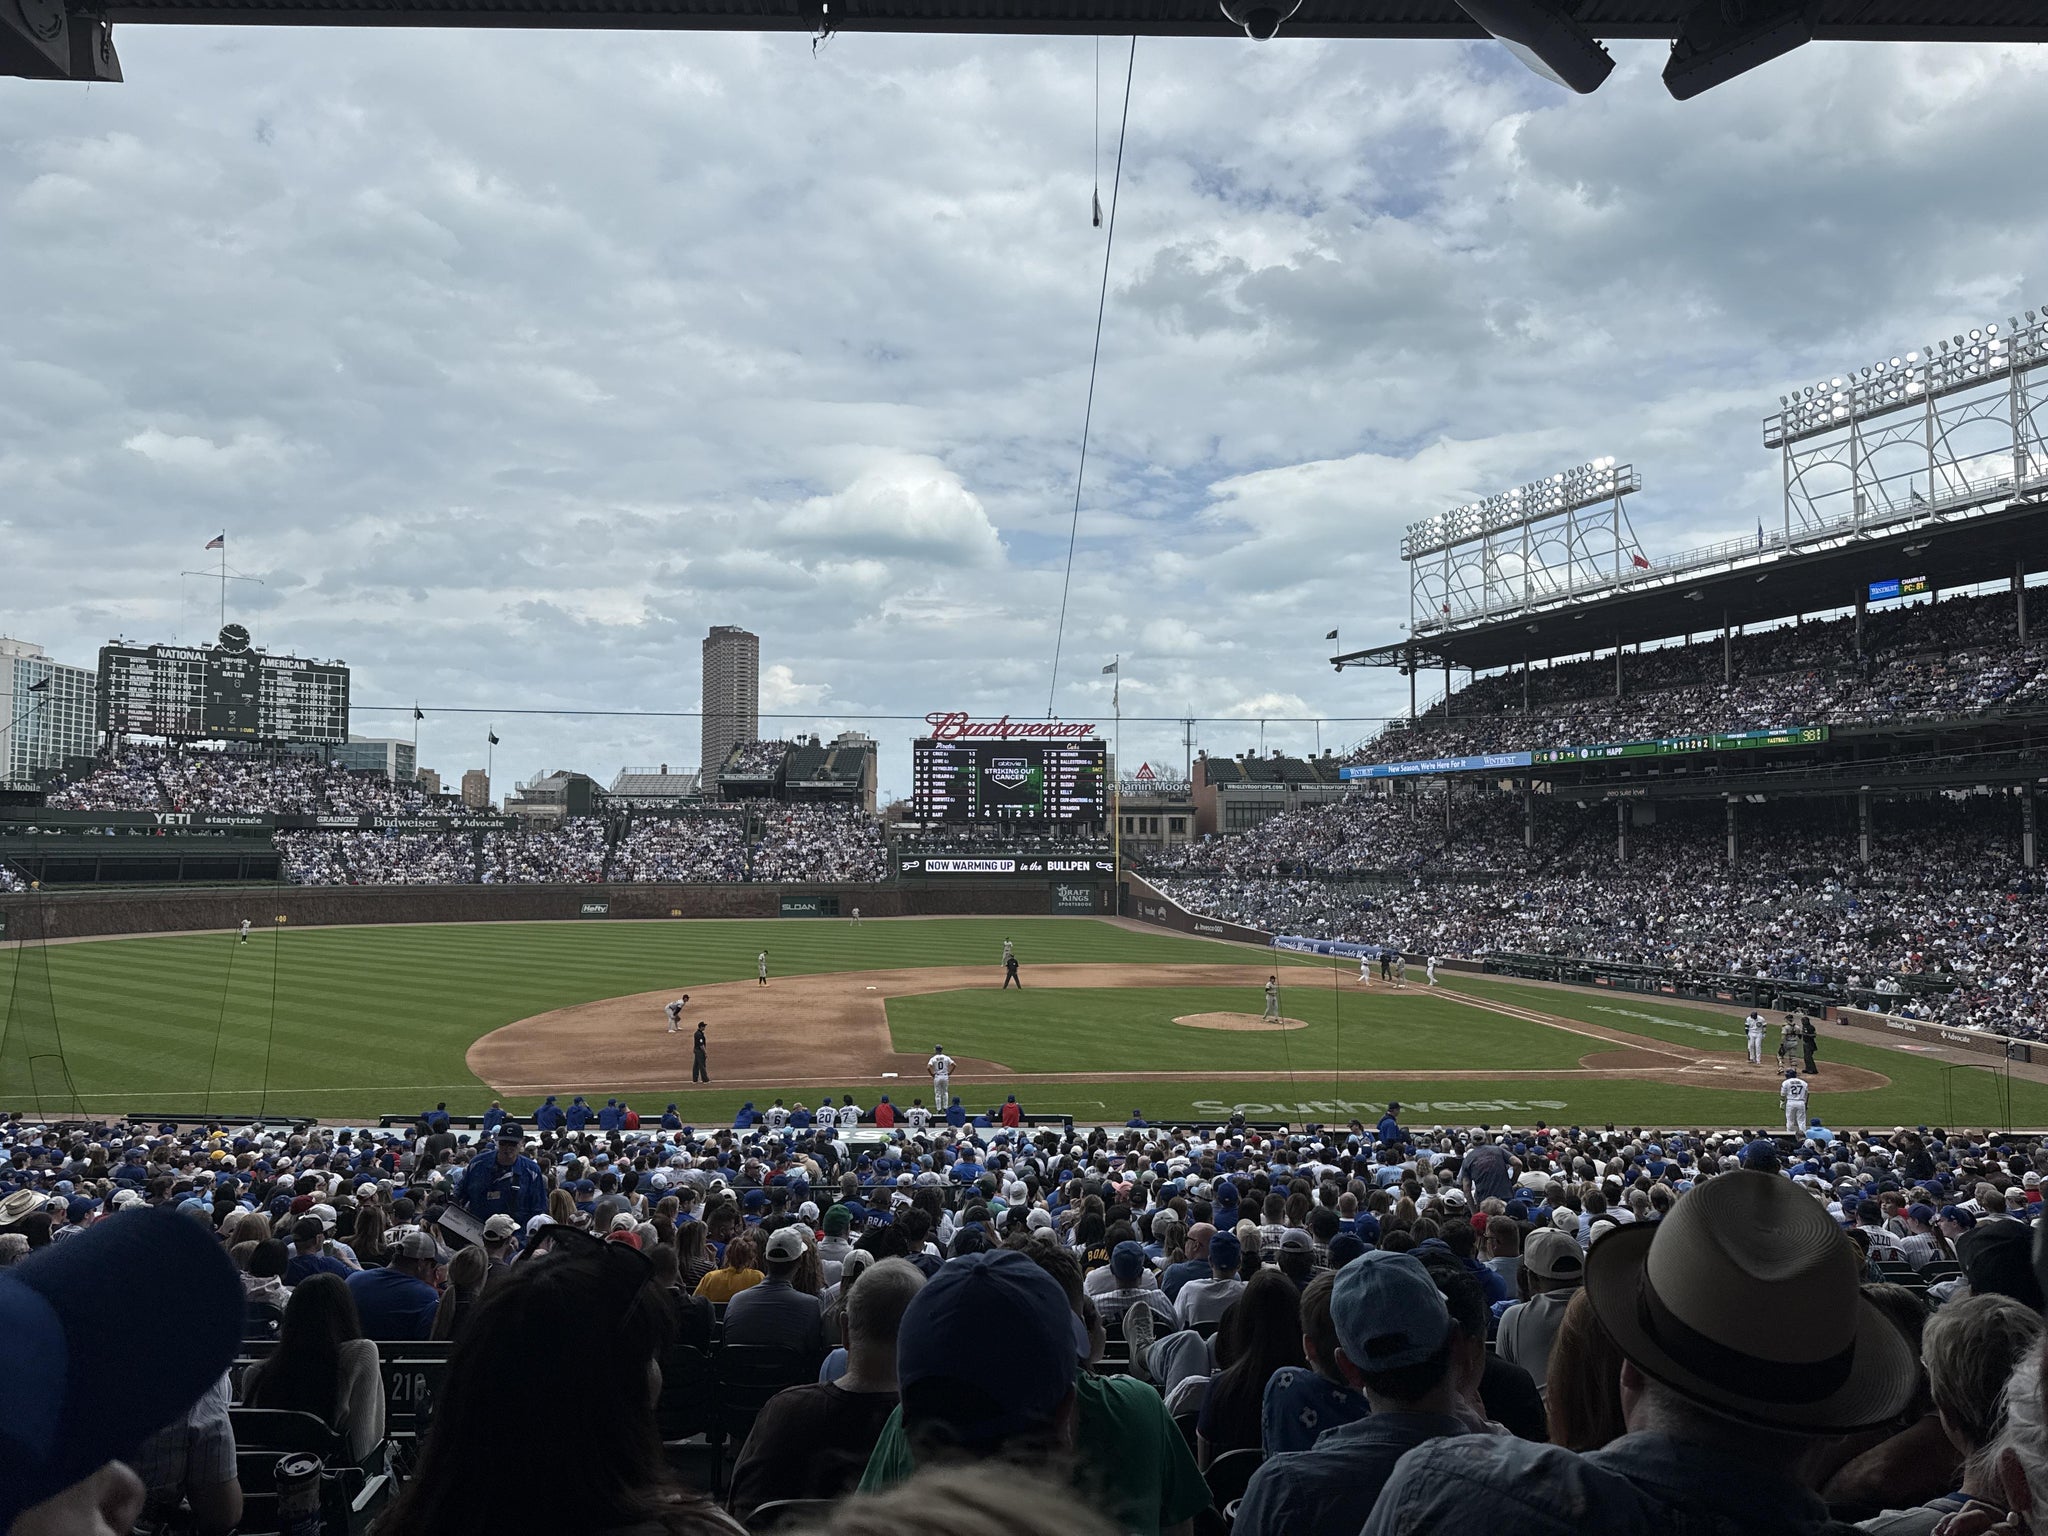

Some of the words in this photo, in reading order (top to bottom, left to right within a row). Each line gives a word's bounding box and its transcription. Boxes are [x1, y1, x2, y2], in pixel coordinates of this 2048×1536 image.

[1916, 582, 1924, 590] 81
[156, 648, 208, 662] NATIONAL
[221, 657, 247, 665] UMPIRES
[260, 658, 307, 670] AMERICAN
[234, 679, 241, 688] 8
[230, 715, 236, 724] 2
[925, 712, 1097, 740] Budweiser
[1690, 741, 1696, 749] 2
[1703, 739, 1709, 748] 2
[1560, 752, 1564, 760] 3
[1606, 747, 1623, 756] HAPP
[1484, 757, 1516, 766] WINTRUST
[1349, 768, 1373, 776] WINTRUST
[1388, 765, 1400, 773] New
[1401, 764, 1420, 774] Season,
[1421, 762, 1436, 770] We're
[1437, 761, 1450, 769] Here
[1451, 760, 1460, 768] For
[13, 782, 41, 791] Mobile
[1106, 780, 1152, 792] enjamin
[1154, 780, 1190, 791] Moore
[154, 813, 191, 825] YETI
[213, 816, 263, 826] tastytrade
[463, 818, 504, 827] Advocate
[927, 861, 950, 871] NOW
[952, 861, 998, 871] WARMING
[1000, 861, 1014, 871] UP
[1020, 861, 1029, 871] in
[1030, 861, 1043, 871] the
[1047, 861, 1090, 871] BULLPEN
[1058, 888, 1091, 897] DRAFT
[583, 905, 606, 913] Hefty
[781, 903, 816, 911] SLOAN
[1200, 924, 1214, 932] Invesco
[1947, 1032, 1971, 1043] Advocate
[938, 1061, 943, 1070] 0
[1790, 1085, 1803, 1095] 27
[1192, 1099, 1524, 1115] Southwest
[774, 1115, 781, 1125] 6
[819, 1113, 831, 1123] 20
[843, 1112, 849, 1122] 7
[913, 1115, 919, 1125] 3
